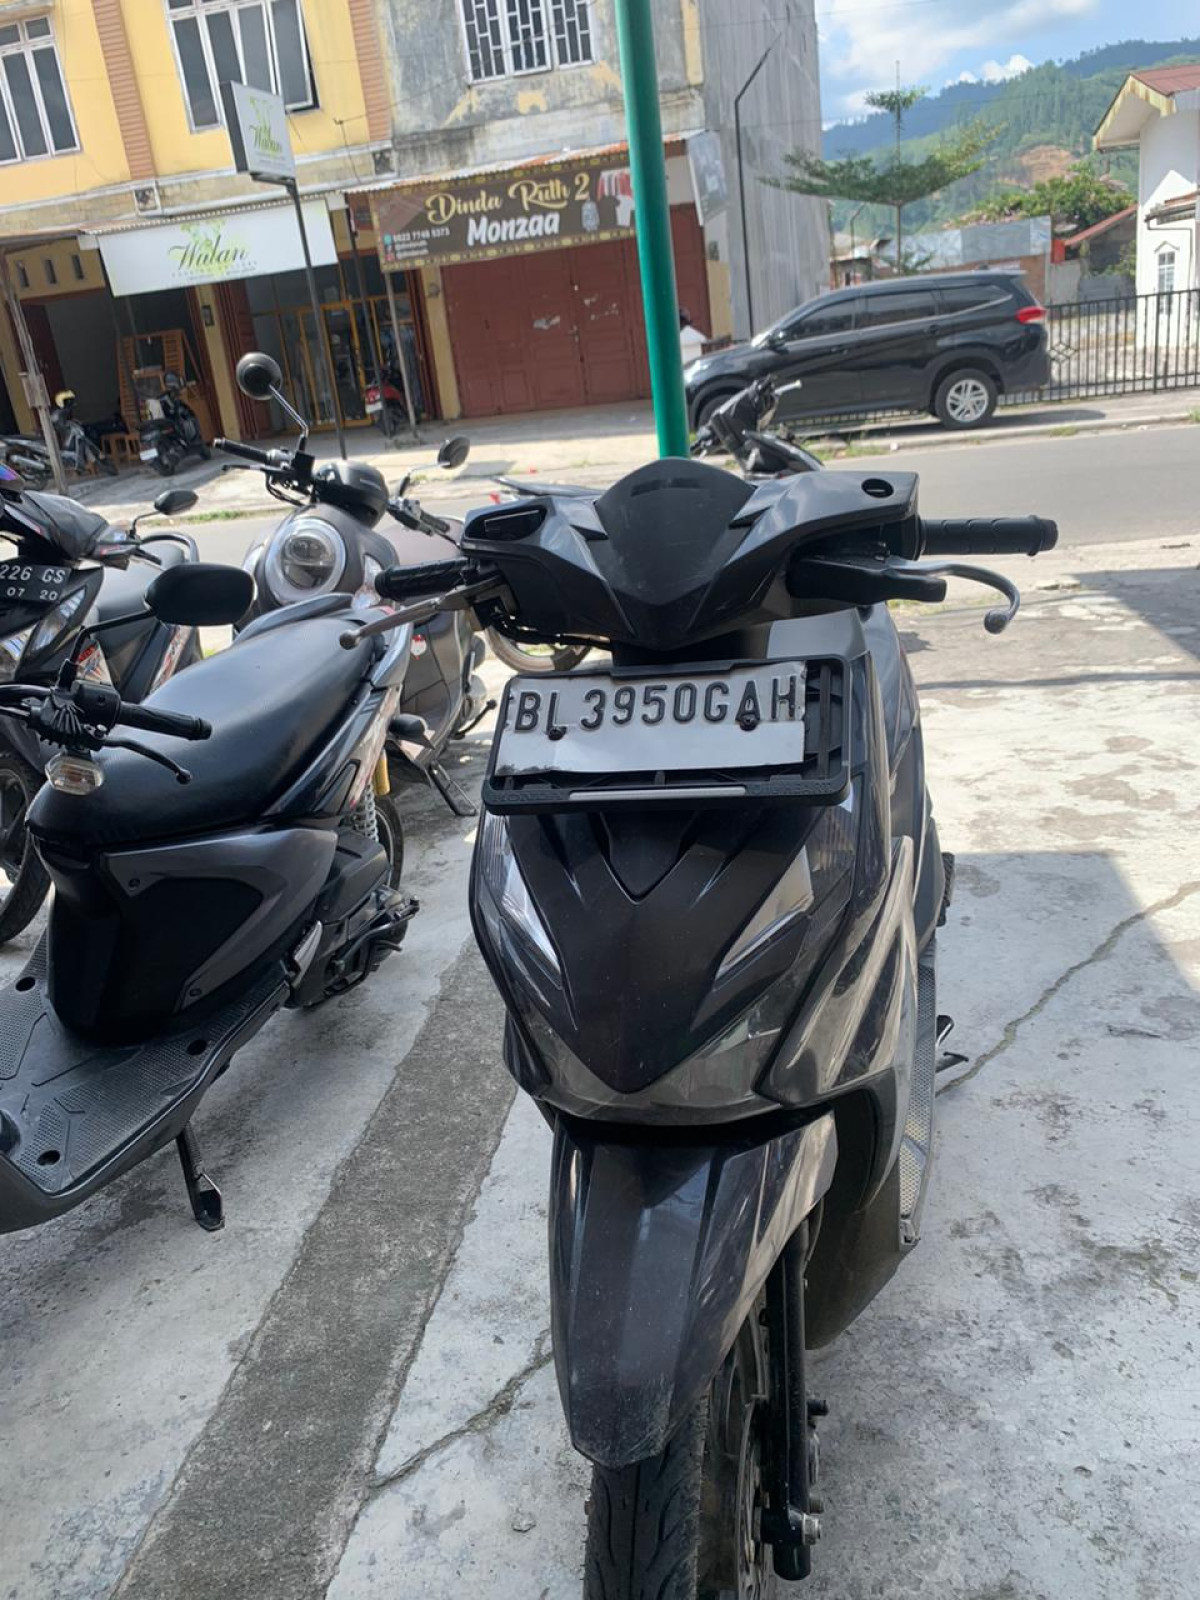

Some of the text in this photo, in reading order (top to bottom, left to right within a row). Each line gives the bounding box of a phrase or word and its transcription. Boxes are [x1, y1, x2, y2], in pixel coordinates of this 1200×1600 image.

[426, 172, 591, 225] Dinda Ruth 2
[467, 211, 561, 247] Monzaa
[167, 234, 250, 271] Wulan
[0, 564, 66, 584] 226 GS
[7, 587, 59, 601] 07 20
[514, 691, 568, 735] BL
